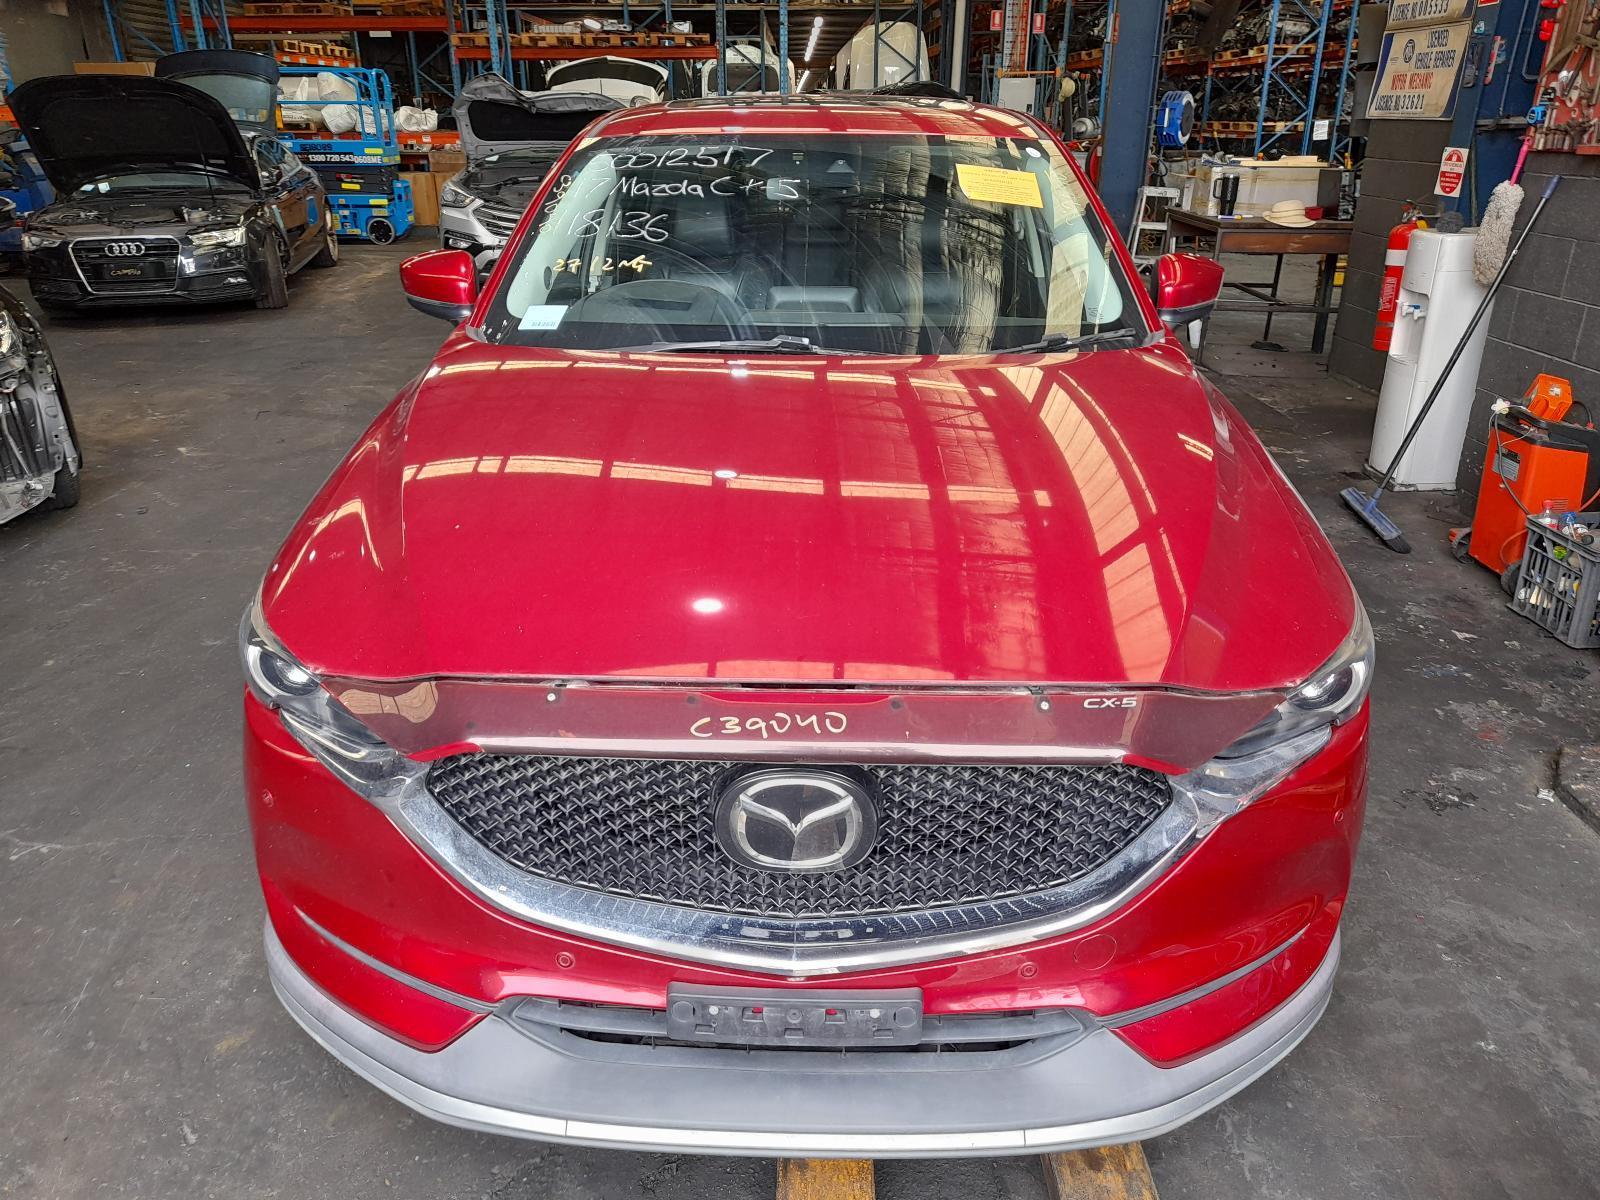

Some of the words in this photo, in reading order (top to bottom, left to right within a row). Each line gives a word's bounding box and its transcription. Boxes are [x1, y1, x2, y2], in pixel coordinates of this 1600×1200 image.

[1391, 73, 1407, 91] MOTOR
[1408, 72, 1433, 90] MECHANIC
[609, 176, 704, 199] Mazda
[1083, 697, 1138, 709] CX-5
[690, 711, 848, 739] C39040
